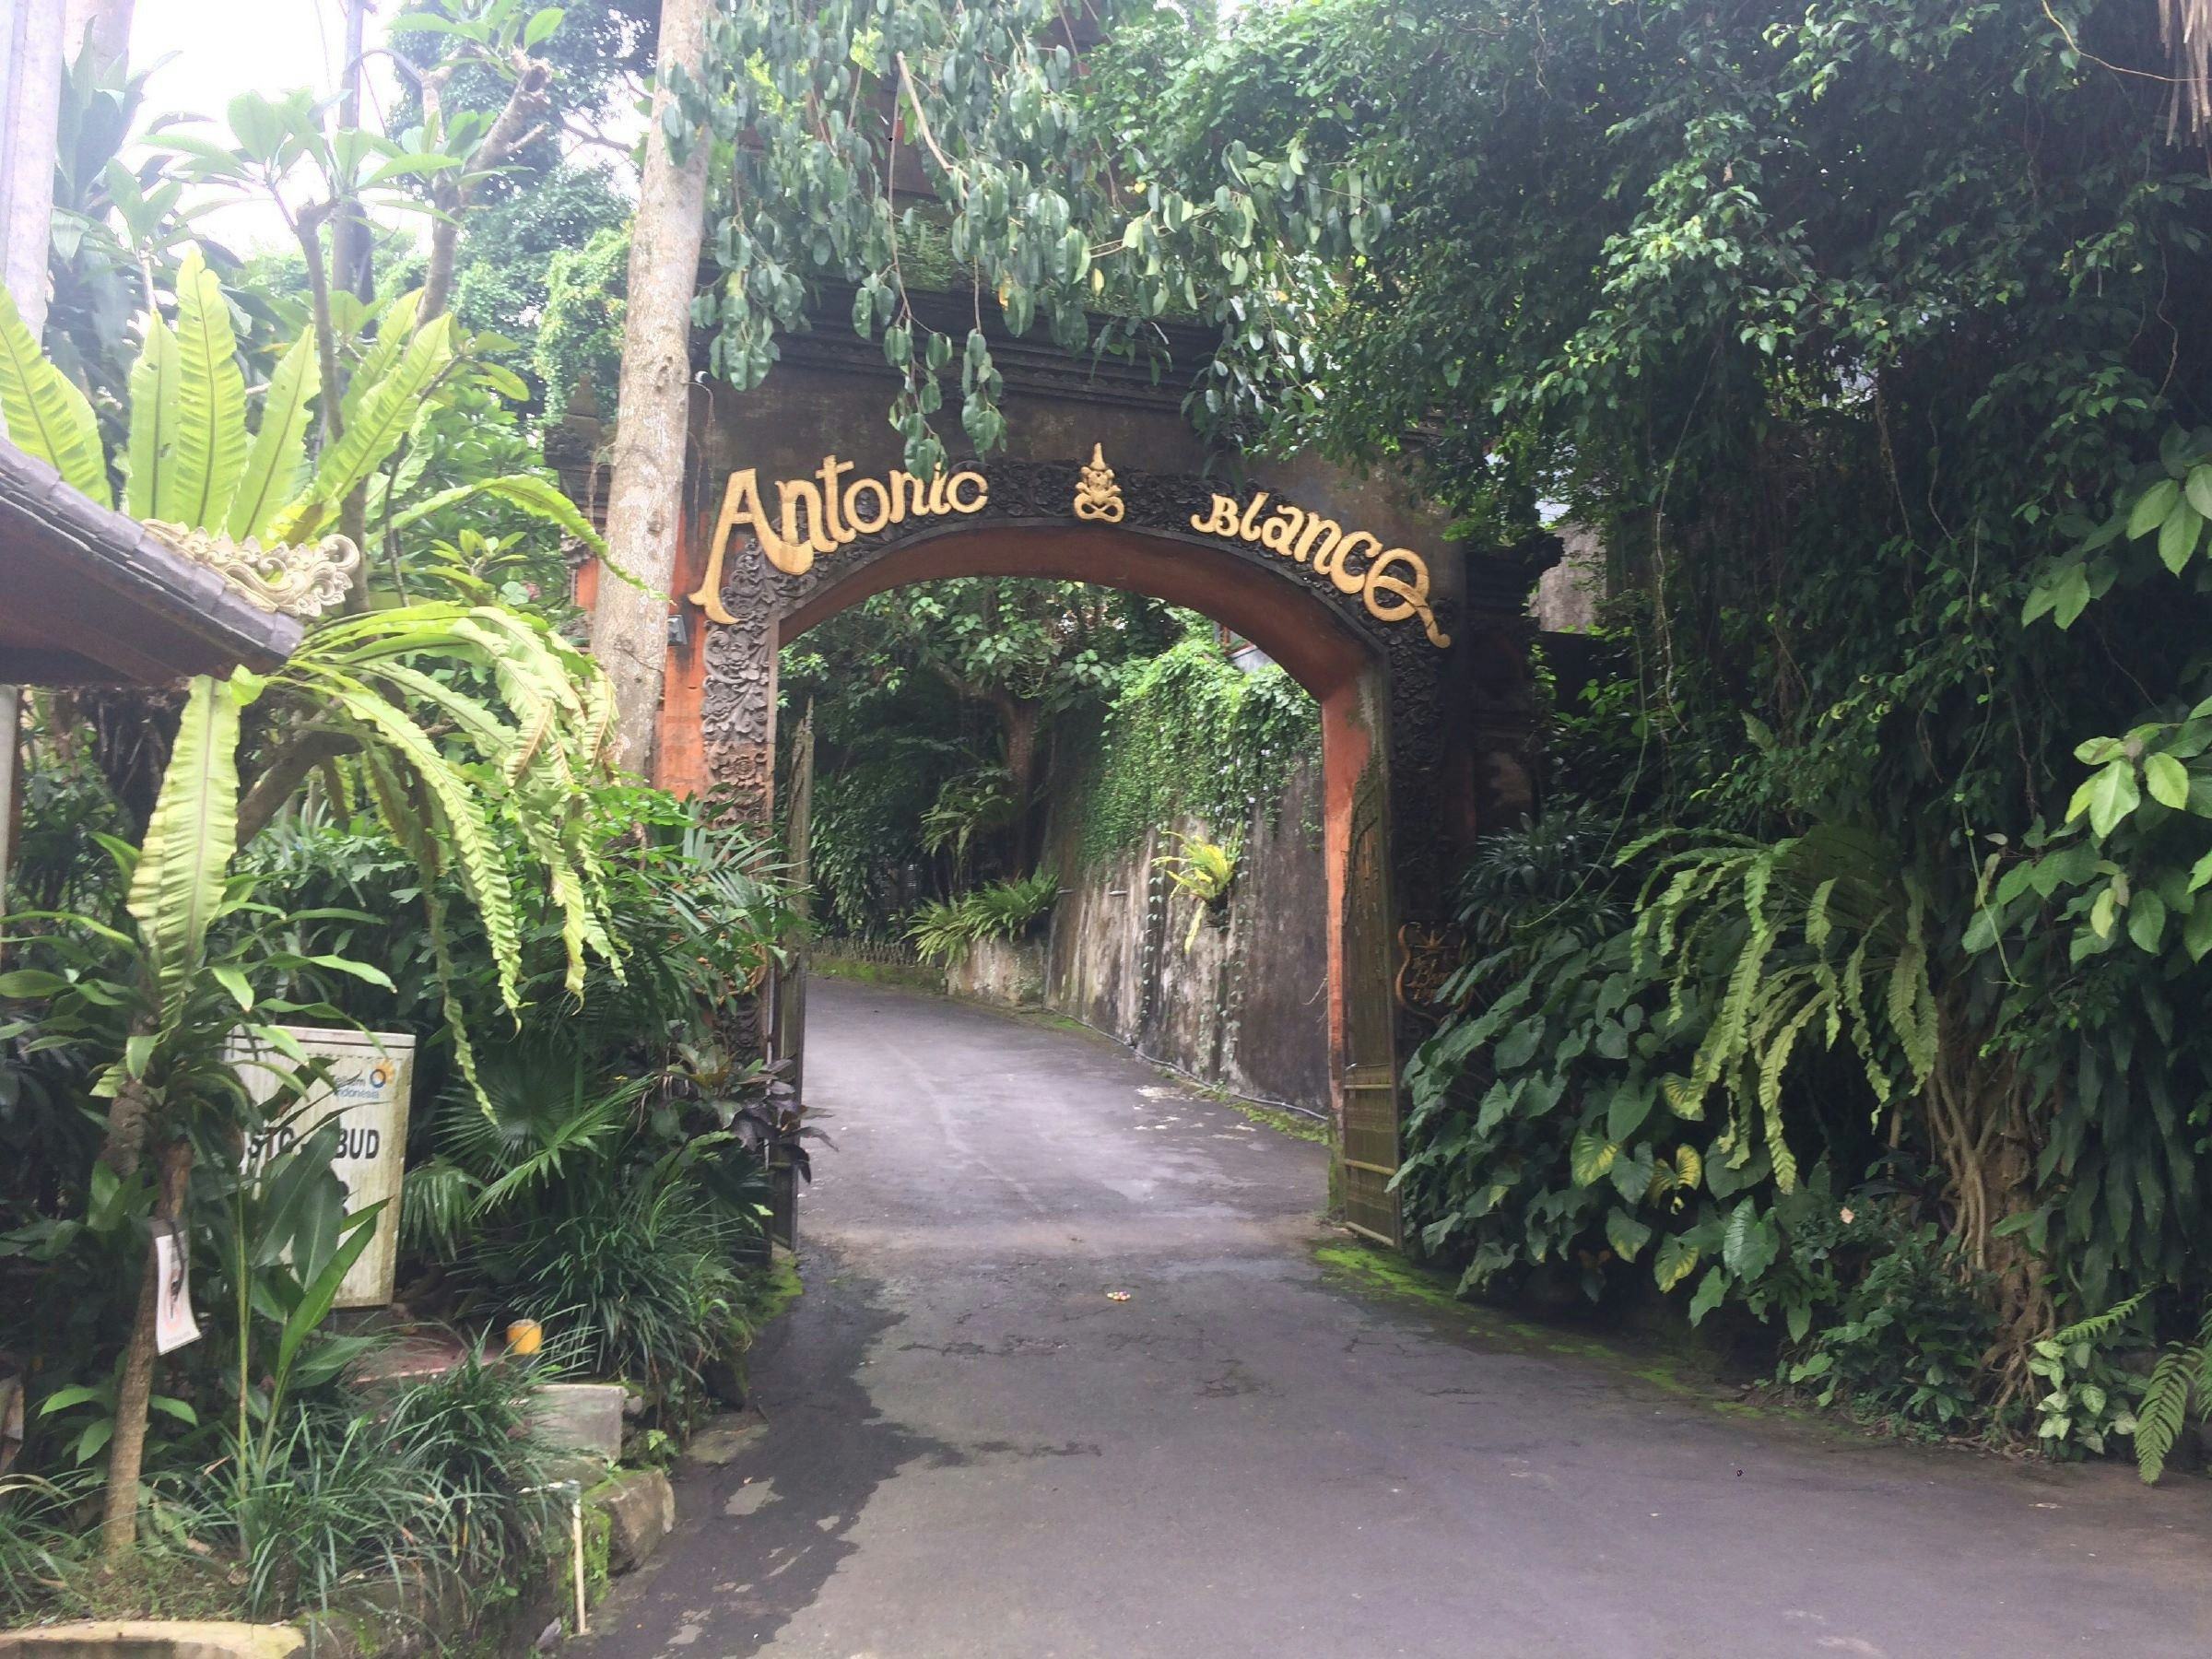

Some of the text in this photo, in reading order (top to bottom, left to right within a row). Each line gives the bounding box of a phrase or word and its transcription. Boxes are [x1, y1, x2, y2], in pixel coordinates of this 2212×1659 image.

[688, 454, 1452, 649] Antonio Blanco
[336, 1087, 379, 1099] ndonesia
[335, 1127, 381, 1160] BUD
